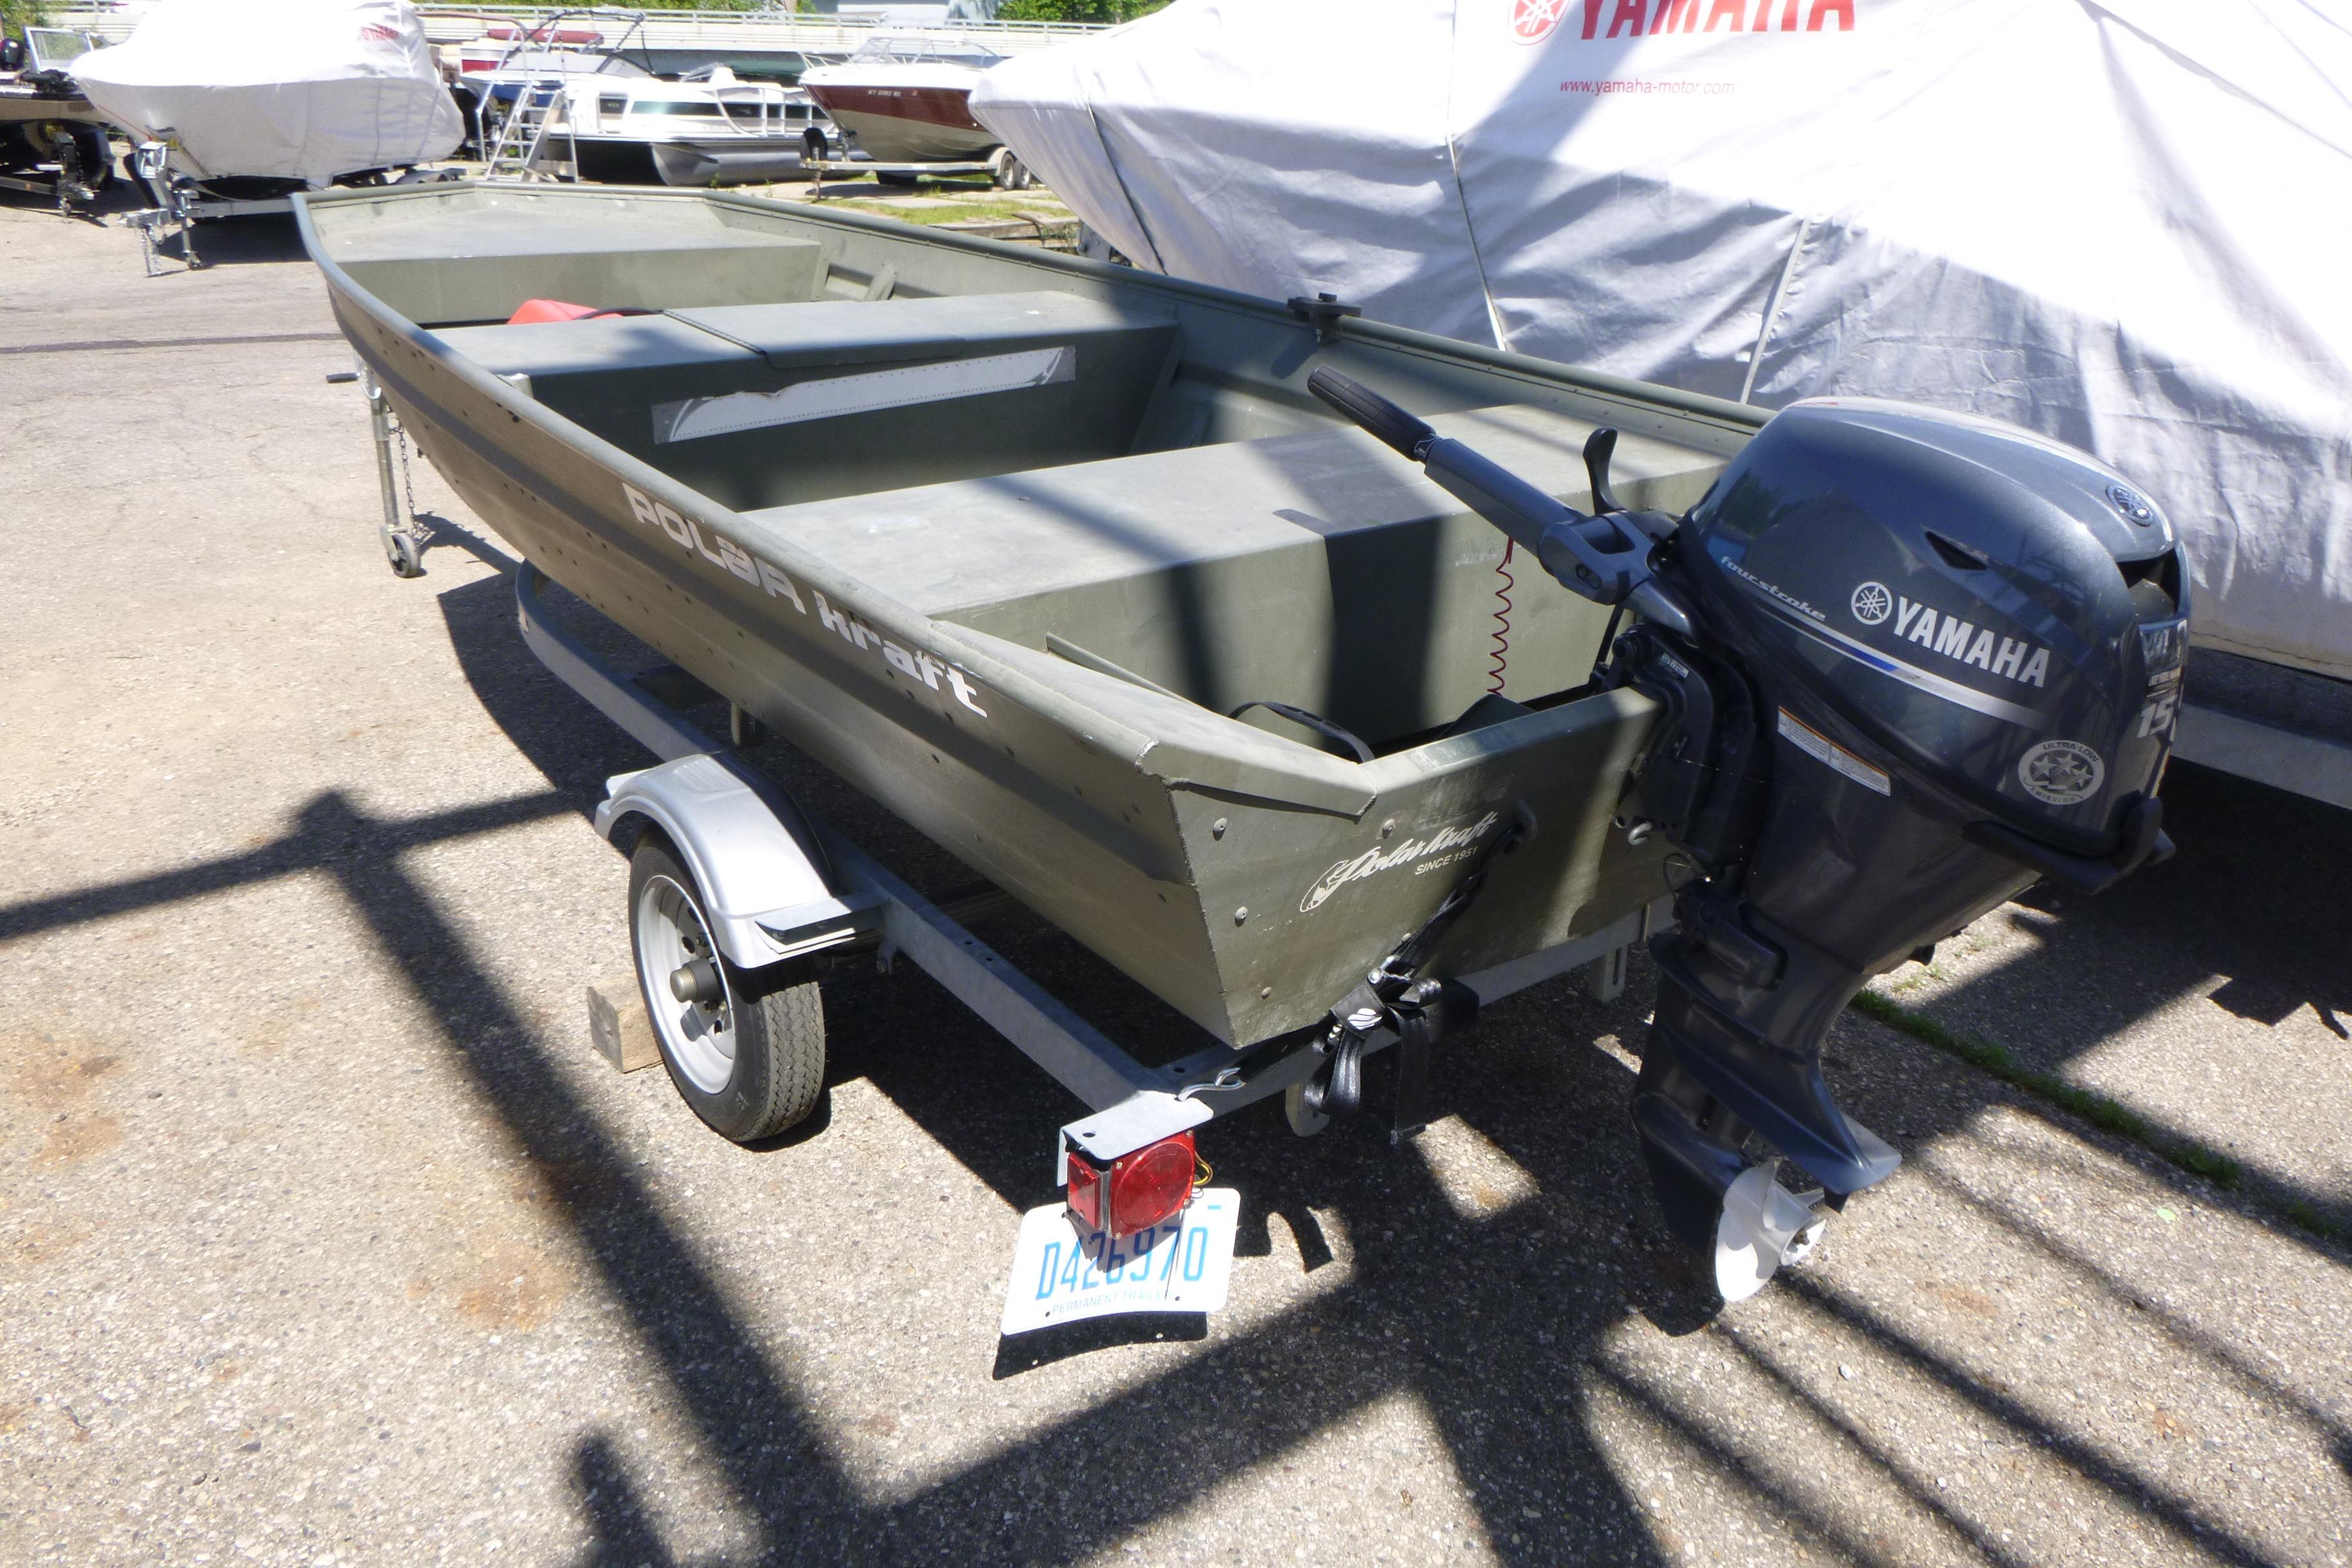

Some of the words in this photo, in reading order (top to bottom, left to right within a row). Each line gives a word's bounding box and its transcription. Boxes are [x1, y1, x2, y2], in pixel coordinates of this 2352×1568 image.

[1560, 77, 1734, 96] www.yamaha-motor.com
[1894, 596, 2050, 688] YAMAHA
[1415, 856, 1451, 875] SINCE
[1454, 846, 1479, 862] 1951
[1035, 1226, 1208, 1300] D426970
[1052, 1290, 1119, 1315] PERMANENT
[1122, 1289, 1173, 1301] TRAILER
